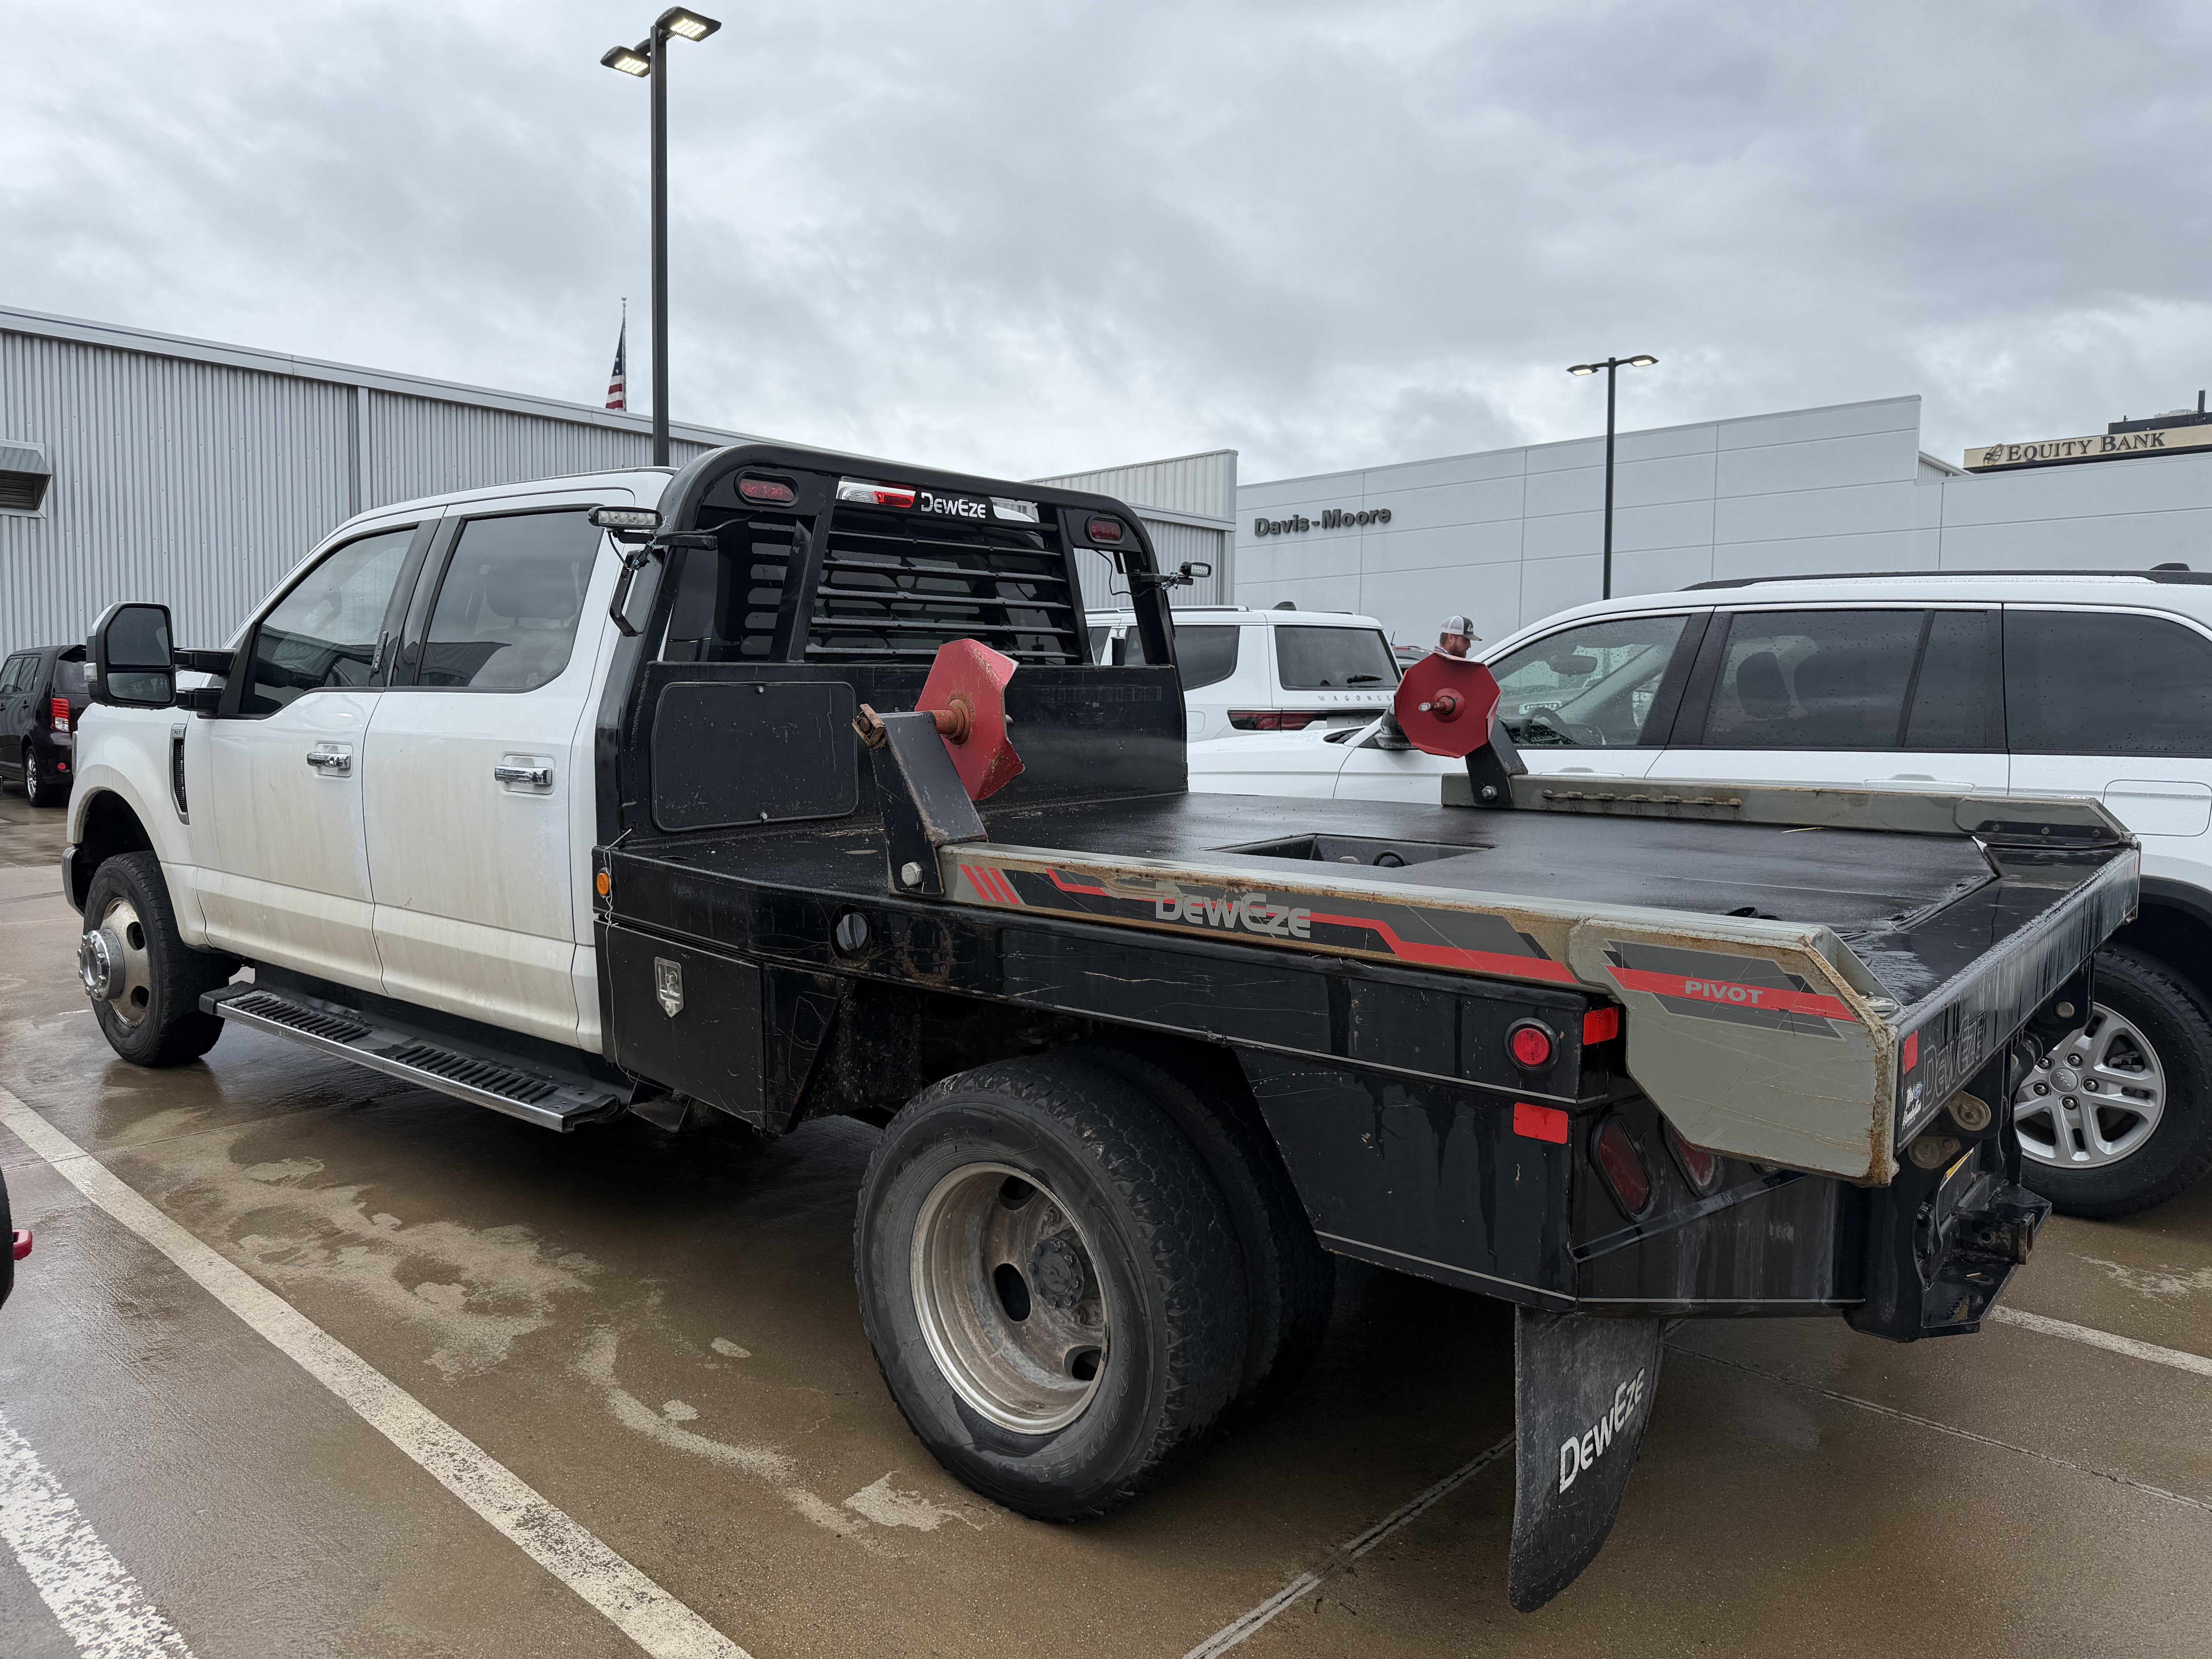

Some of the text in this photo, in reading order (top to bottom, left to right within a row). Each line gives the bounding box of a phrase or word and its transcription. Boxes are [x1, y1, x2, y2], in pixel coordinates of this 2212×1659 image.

[2006, 432, 2165, 462] EQUITY BANK
[1255, 508, 1391, 537] Davis-Moore
[1685, 980, 1763, 1003] PIVOT
